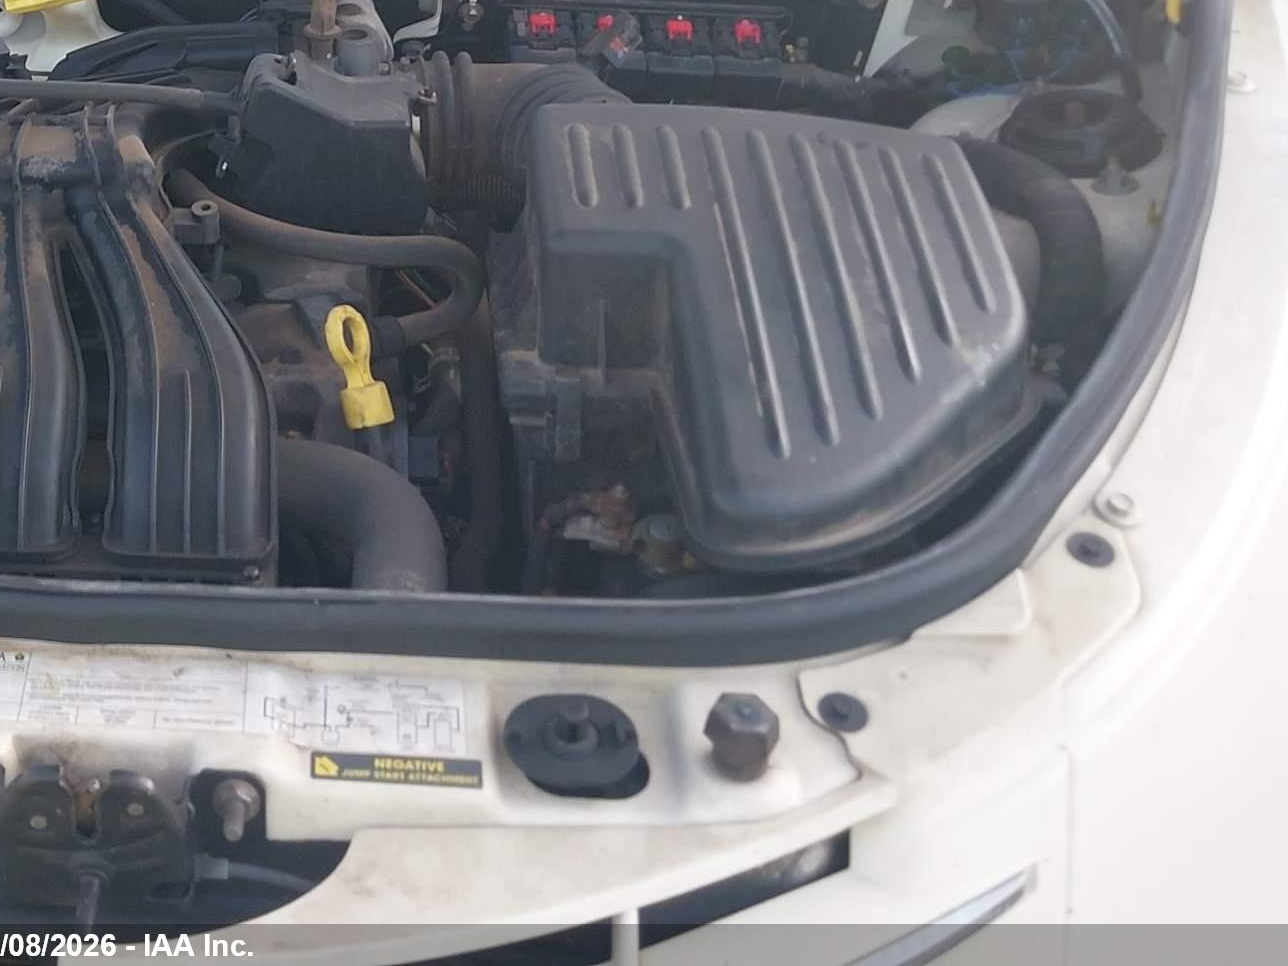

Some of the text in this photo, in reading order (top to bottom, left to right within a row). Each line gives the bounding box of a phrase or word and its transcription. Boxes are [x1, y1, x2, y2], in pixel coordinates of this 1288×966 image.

[374, 758, 445, 773] NEGATIVE
[374, 770, 405, 780] START
[408, 771, 479, 785] ATTACHMENT
